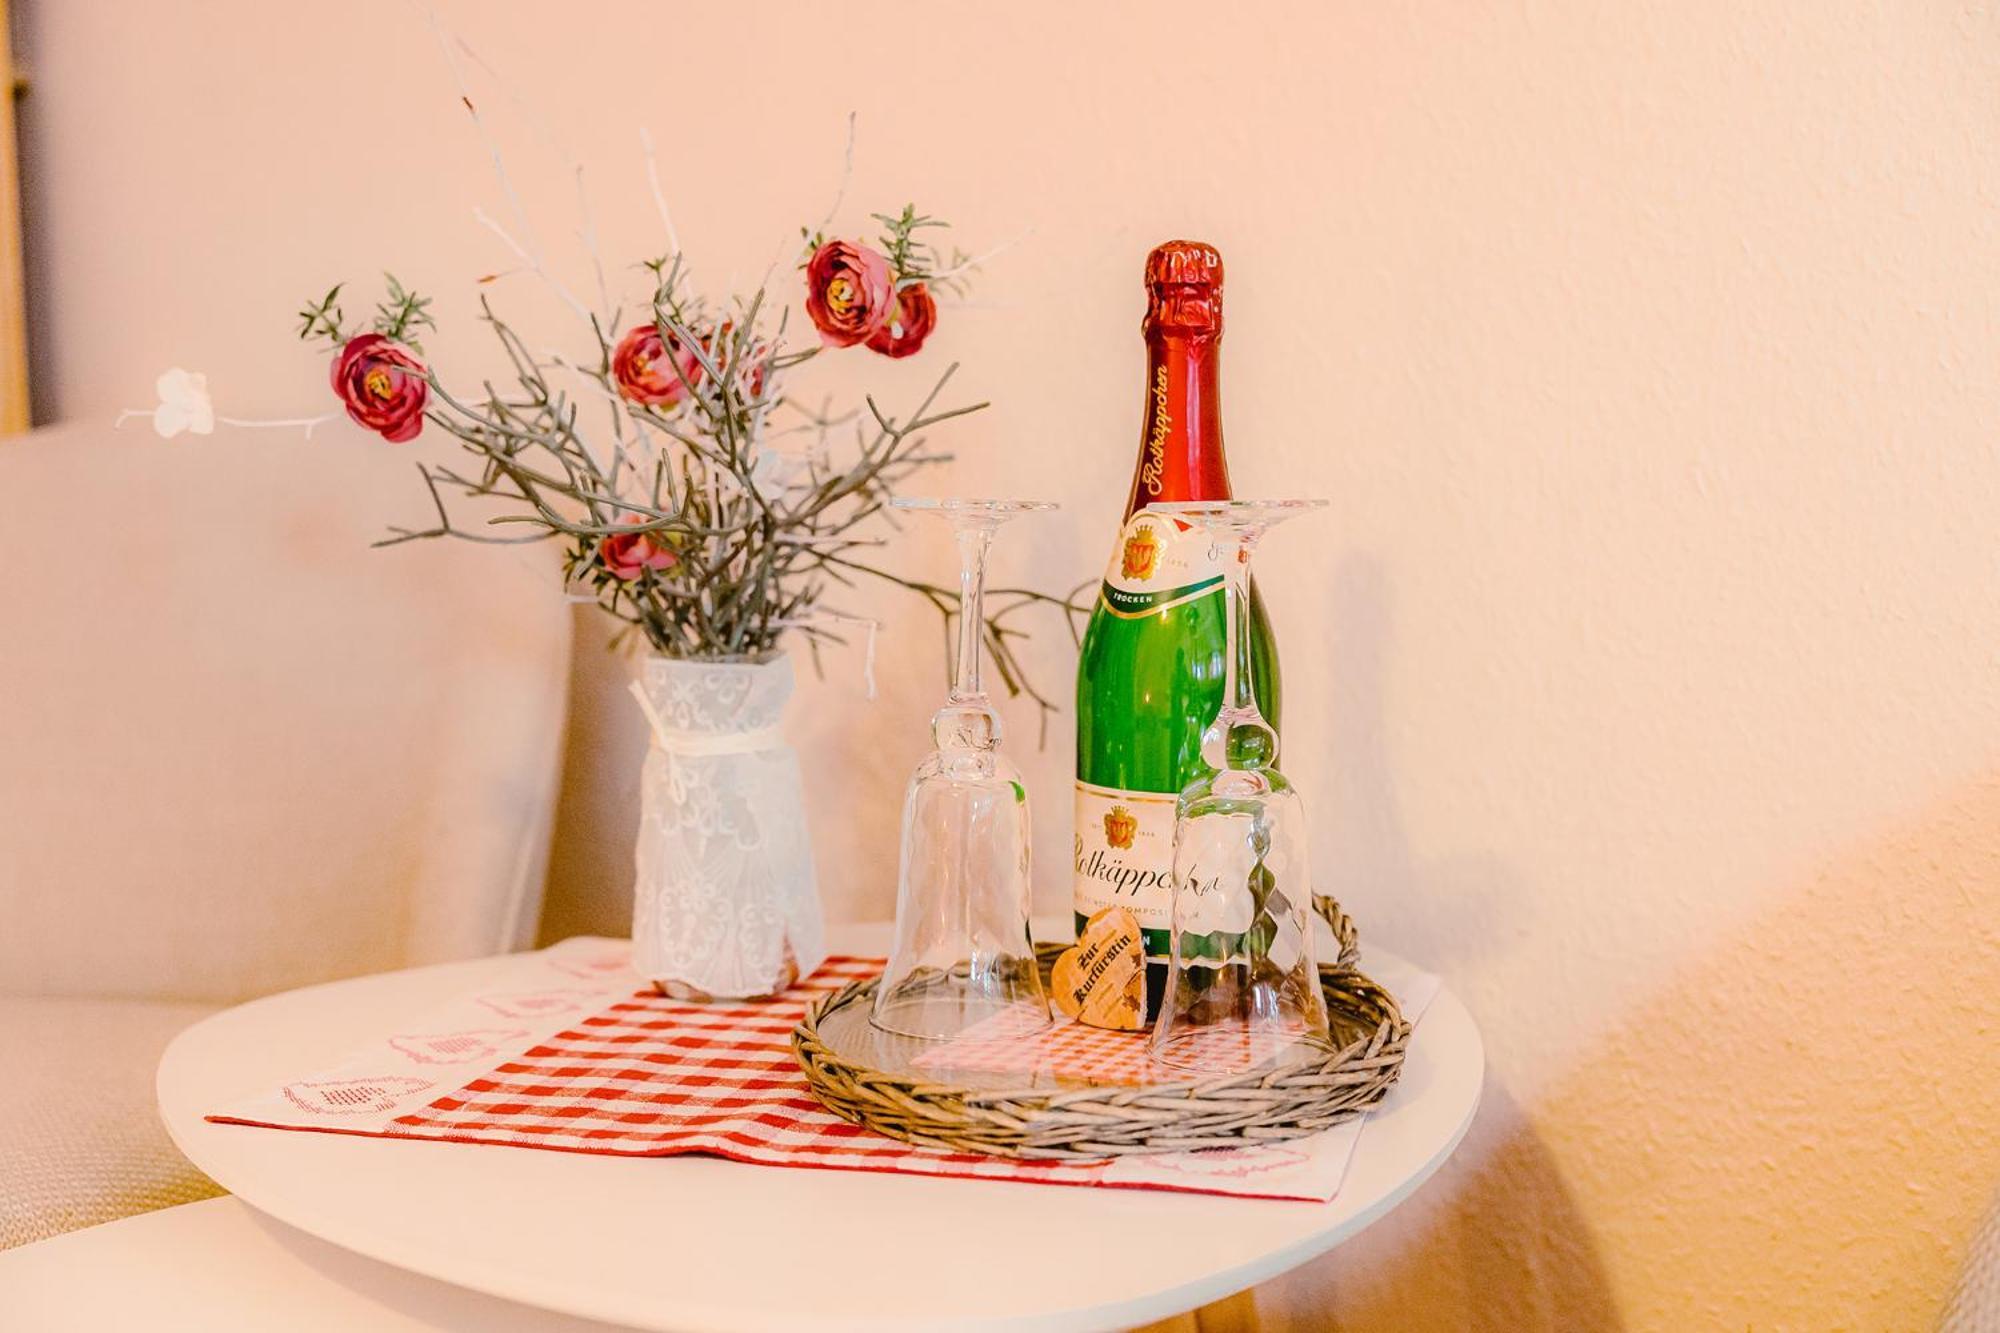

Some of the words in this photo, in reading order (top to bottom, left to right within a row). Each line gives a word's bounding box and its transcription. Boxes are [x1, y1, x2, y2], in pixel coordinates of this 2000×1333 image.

[1142, 364, 1172, 496] Rotkäppchen
[1113, 592, 1153, 603] TROCKEN
[1075, 833, 1220, 897] otkäppc
[1073, 934, 1131, 1006] Kurfürstin
[1077, 942, 1100, 970] Zur
